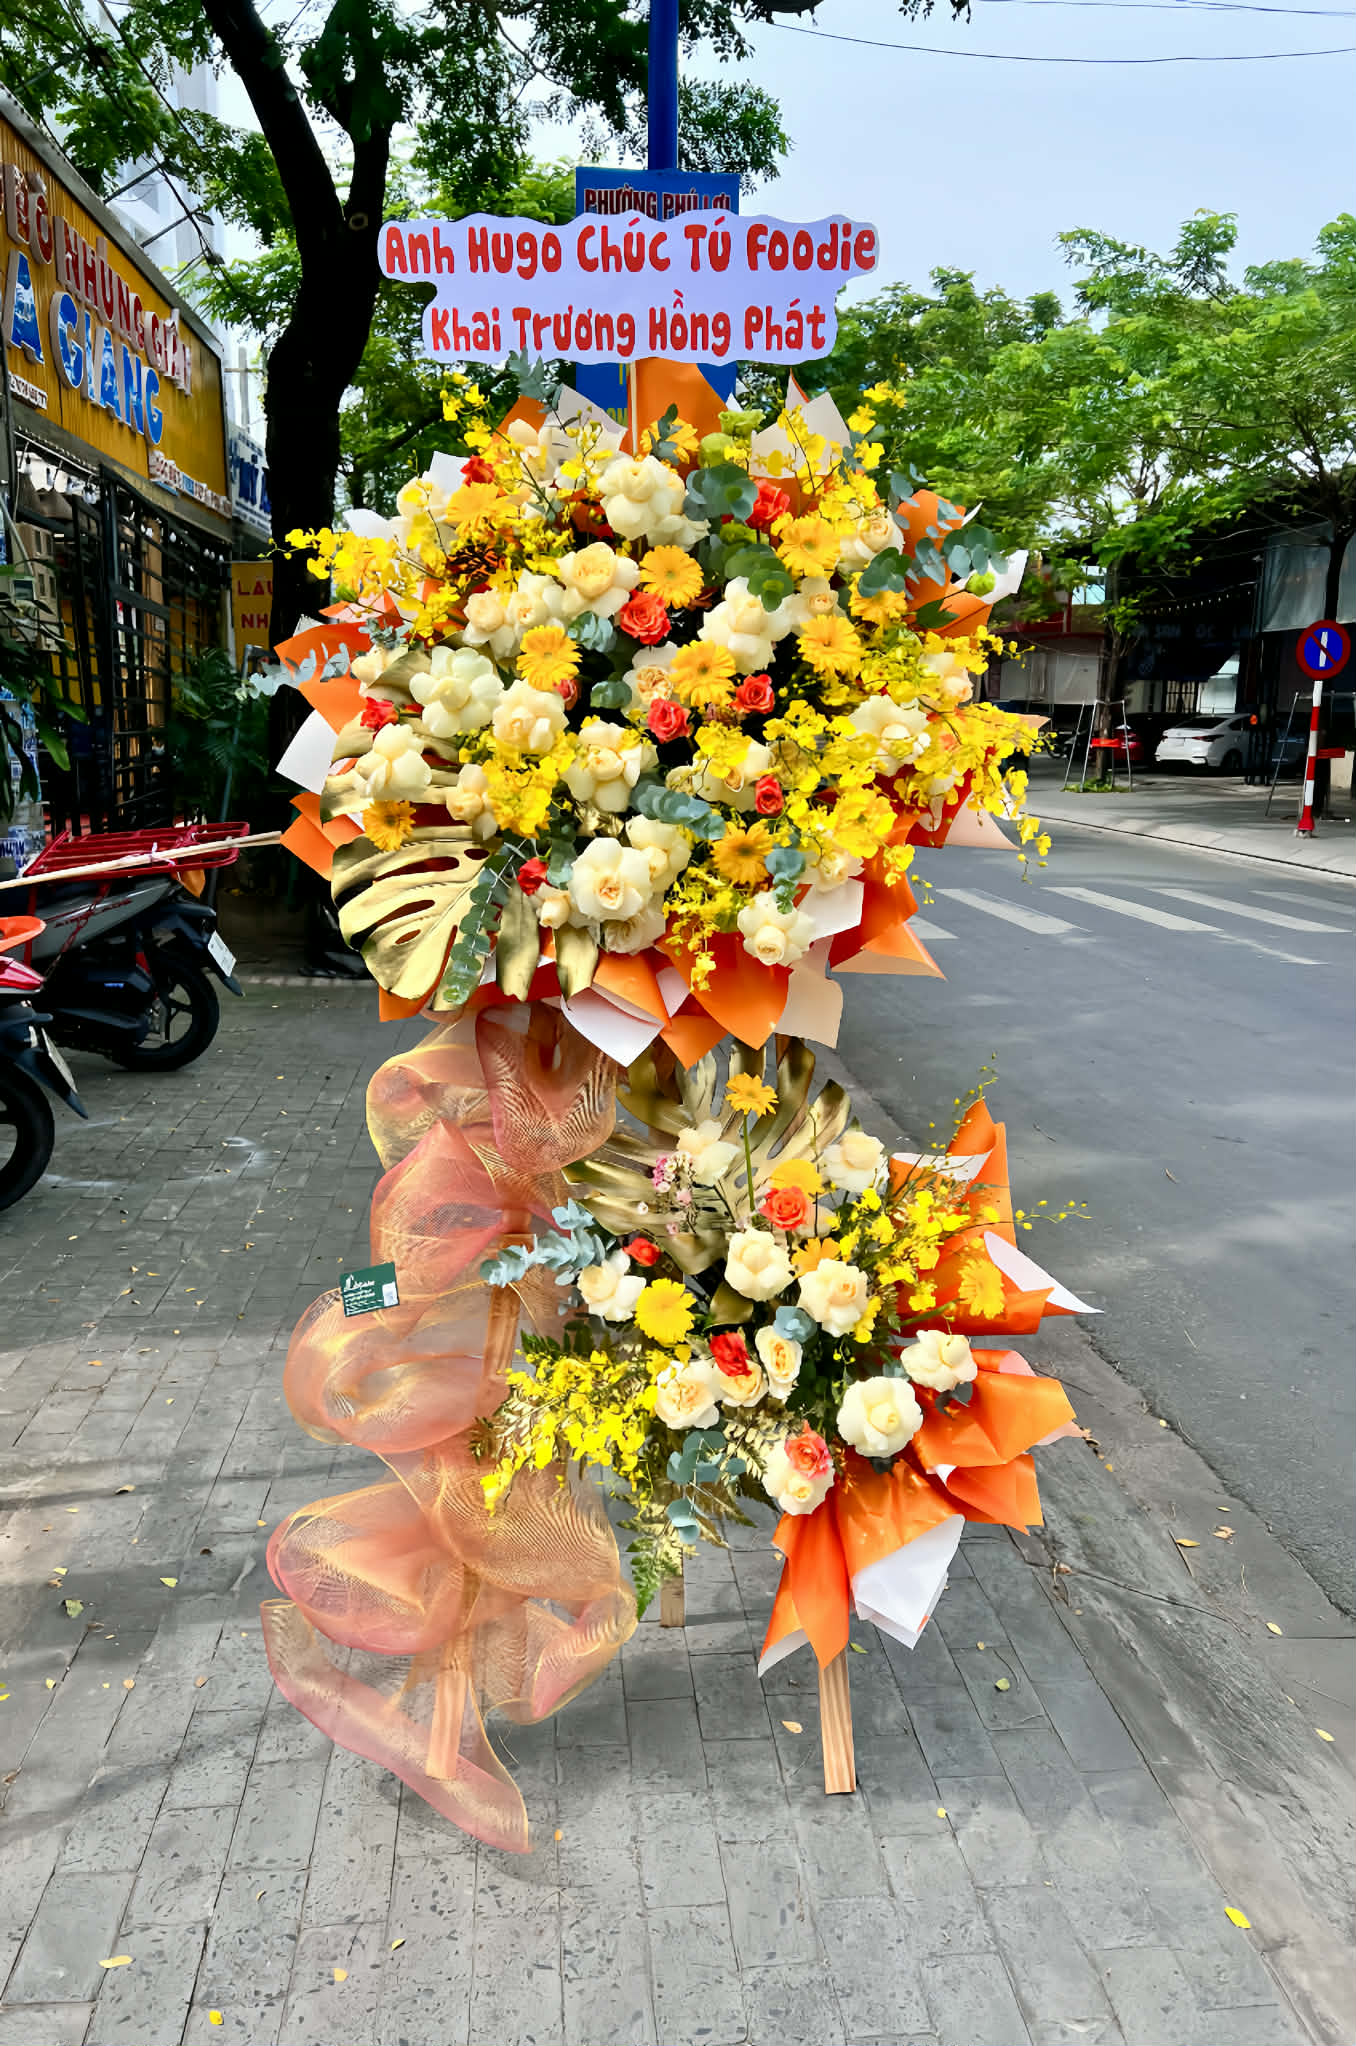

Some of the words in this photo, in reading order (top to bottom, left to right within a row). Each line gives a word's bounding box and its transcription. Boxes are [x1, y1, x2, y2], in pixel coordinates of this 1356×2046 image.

[385, 225, 455, 274] Anh
[468, 226, 562, 280] Hugo
[576, 216, 670, 272] Chúc
[684, 215, 731, 272] Tú
[746, 222, 876, 271] Foodie
[431, 306, 501, 351] Khai
[511, 304, 636, 357] Trương
[649, 289, 732, 357] Hồng
[744, 298, 826, 350] Phát
[50, 291, 163, 446] GIANG
